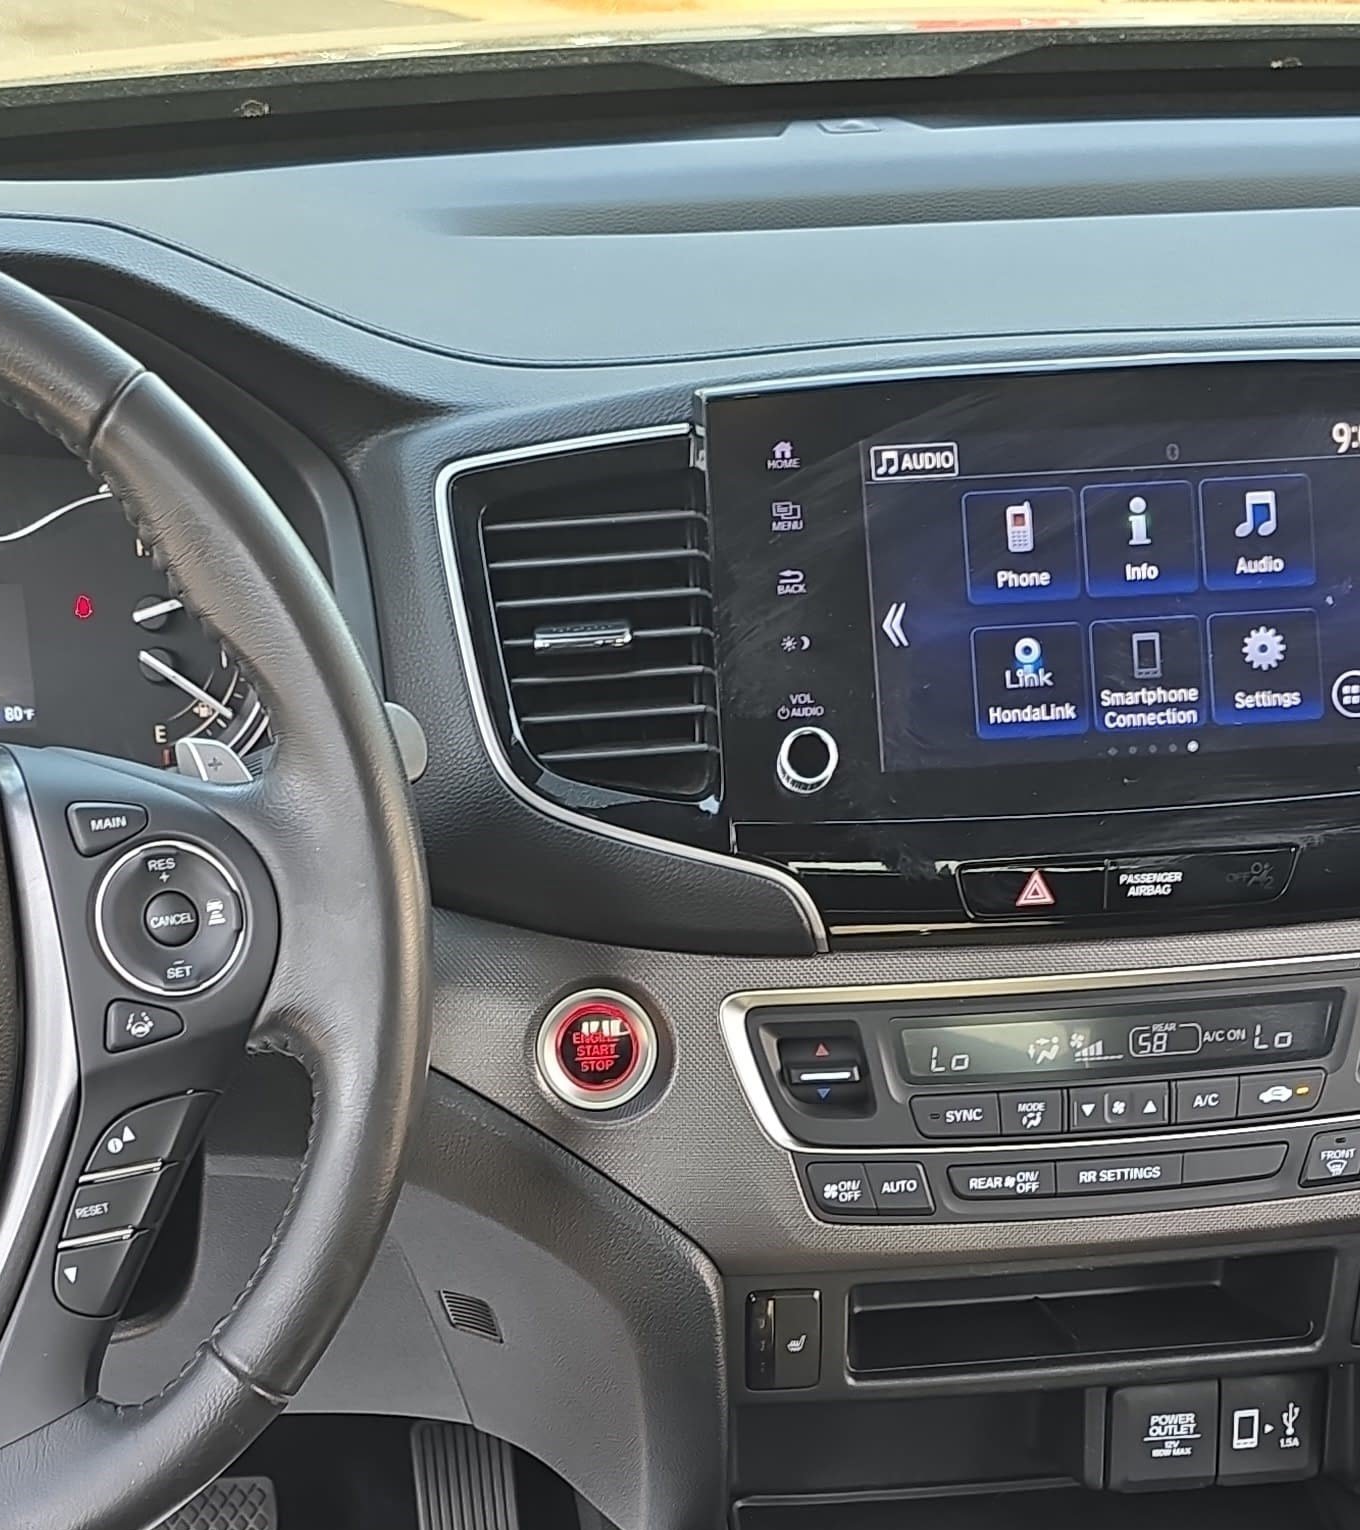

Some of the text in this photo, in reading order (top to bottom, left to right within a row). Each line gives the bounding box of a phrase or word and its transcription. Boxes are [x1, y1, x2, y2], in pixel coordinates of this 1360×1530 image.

[767, 457, 800, 470] HOME
[901, 451, 954, 471] AUDIO
[772, 519, 803, 532] MENU
[1125, 562, 1160, 582] Info
[1235, 555, 1285, 576] Audio
[997, 569, 1051, 590] Phone
[777, 582, 807, 595] BACK
[1005, 667, 1054, 689] Link
[790, 693, 815, 705] VOL
[1100, 685, 1199, 707] Smartphone
[1234, 689, 1302, 710] Settings
[791, 705, 824, 717] AUDIO
[989, 703, 1077, 725] HondaLink
[1104, 706, 1198, 729] Connection
[154, 724, 167, 743] E
[90, 816, 127, 832] MAIN
[147, 858, 176, 872] RES
[1119, 871, 1183, 885] PASSENGER
[1127, 883, 1172, 897] AIRBAG
[150, 912, 195, 929] CANCEL
[166, 965, 193, 979] SET
[1151, 1022, 1177, 1033] REAR
[1202, 1027, 1246, 1044] A/C ON
[1253, 1024, 1293, 1049] Lo
[576, 1044, 617, 1057] START
[580, 1060, 614, 1072] STOP
[930, 1046, 970, 1073] Lo
[1017, 1102, 1045, 1113] MODE
[1193, 1092, 1219, 1109] A/C
[944, 1107, 984, 1124] SYNC
[1320, 1147, 1356, 1161] FRONT
[1016, 1170, 1040, 1183] ON/
[1079, 1166, 1161, 1185] RR SETTINGS
[838, 1180, 861, 1193] ON/
[881, 1180, 918, 1194] AUTO
[969, 1176, 1003, 1191] REAR
[1016, 1180, 1040, 1194] OFF
[839, 1190, 862, 1202] OFF
[75, 1202, 109, 1219] RESET
[1150, 1413, 1196, 1426] POWER
[1148, 1423, 1197, 1437] OUTLET
[1279, 1437, 1300, 1449] 1.5A
[1172, 1447, 1192, 1457] MAX
